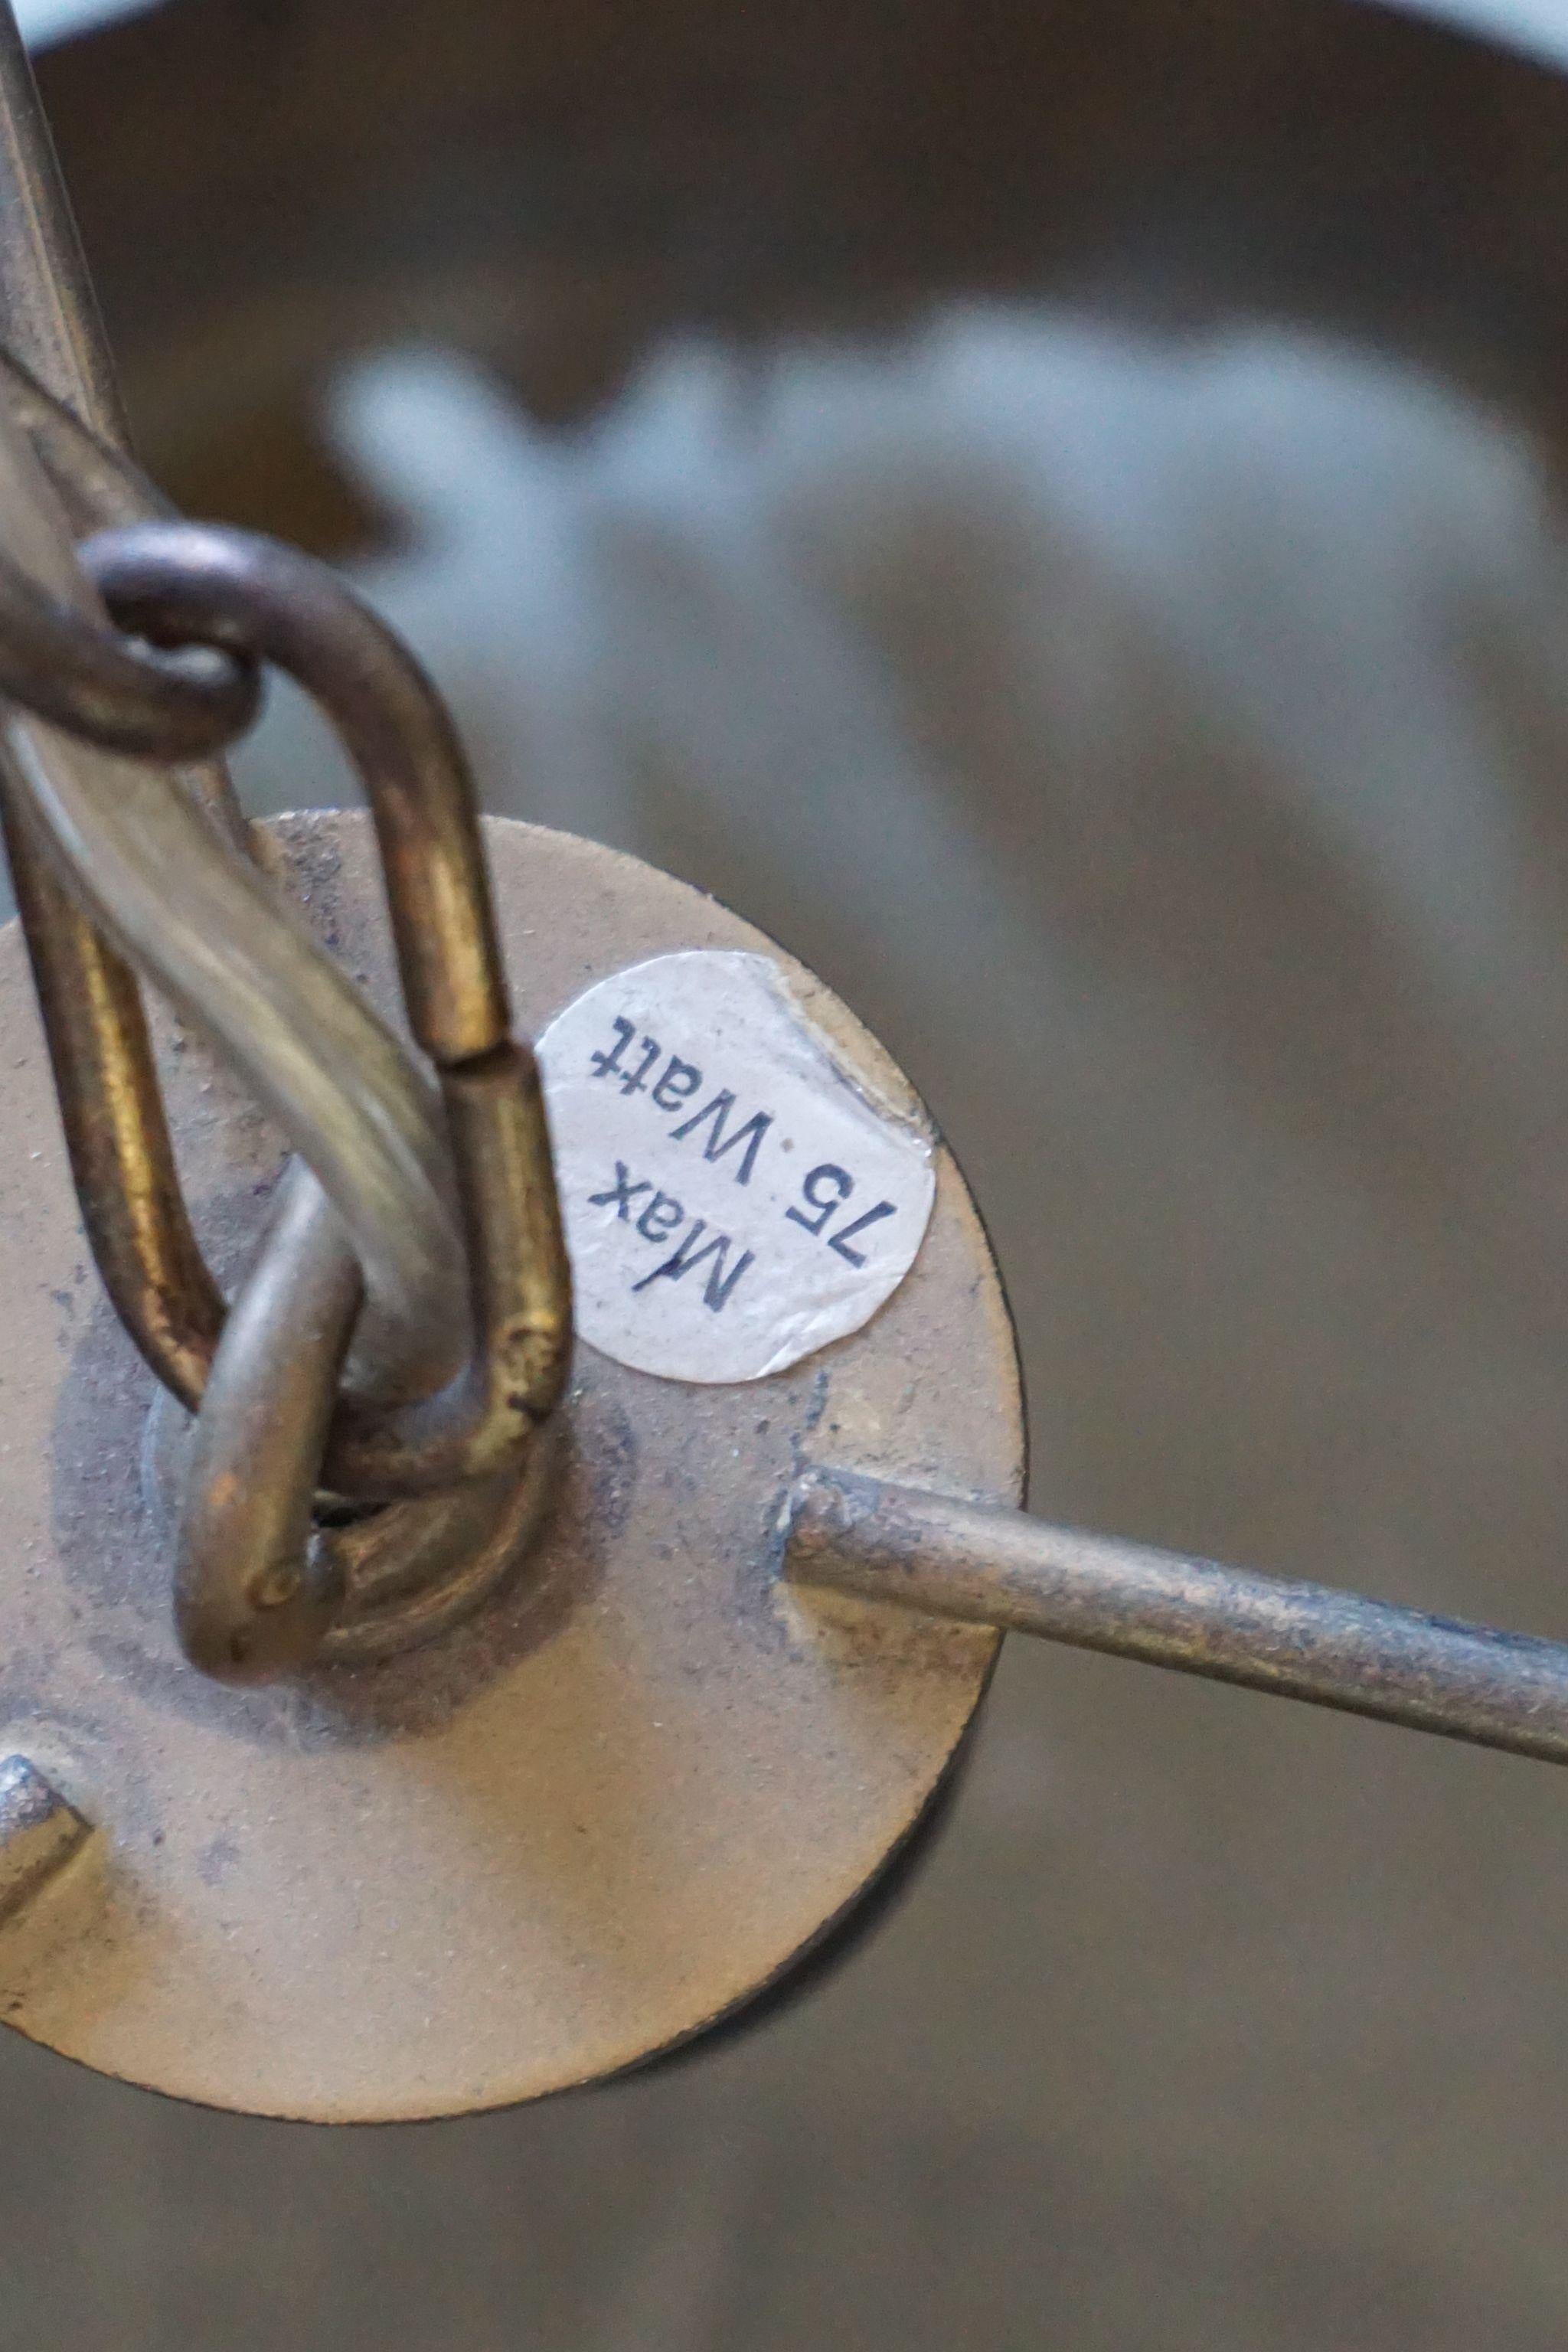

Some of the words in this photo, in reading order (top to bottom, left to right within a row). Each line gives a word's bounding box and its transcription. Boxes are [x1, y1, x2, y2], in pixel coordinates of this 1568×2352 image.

[590, 1015, 774, 1186] Watt
[587, 1160, 756, 1313] Max
[785, 1163, 897, 1268] 75
